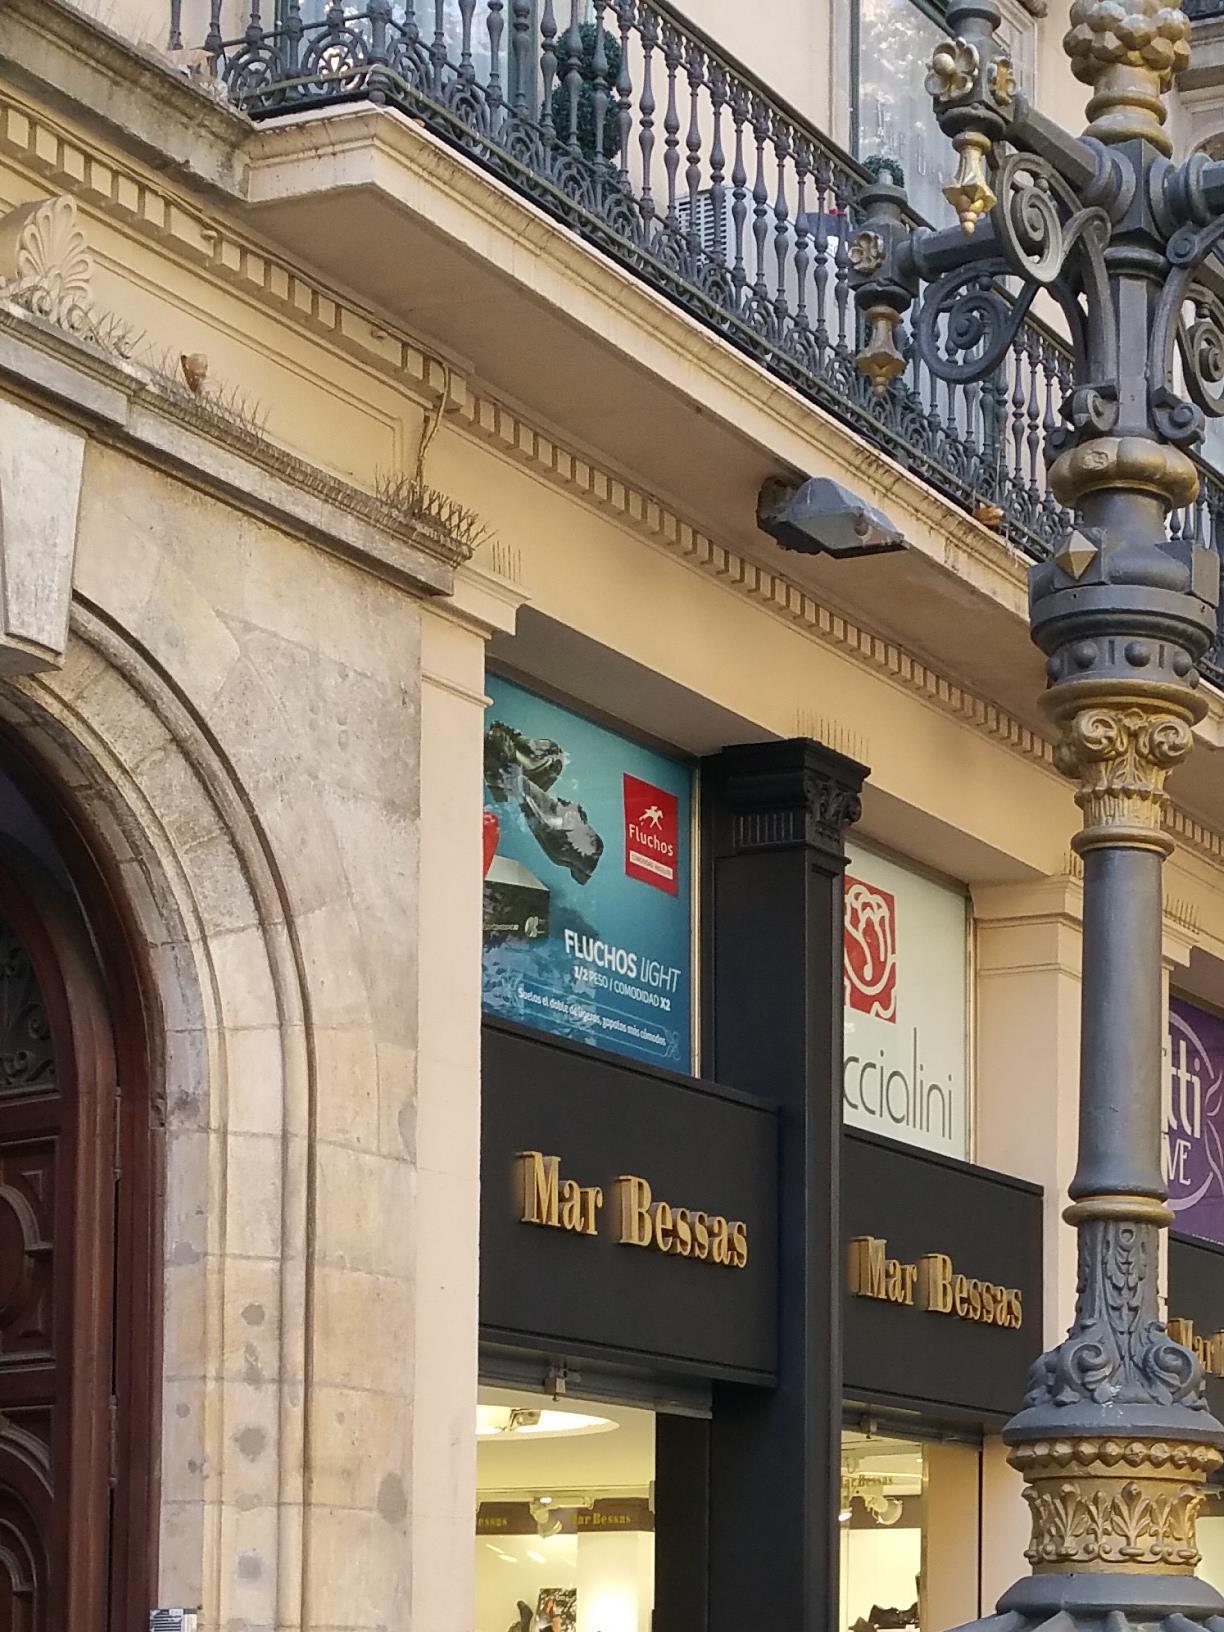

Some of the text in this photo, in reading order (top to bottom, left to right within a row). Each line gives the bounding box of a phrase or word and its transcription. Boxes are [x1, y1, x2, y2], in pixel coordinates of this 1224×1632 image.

[629, 823, 673, 857] Fluchos
[564, 929, 682, 993] FLUCHOS LIGHT
[588, 970, 609, 989] PESO
[613, 980, 660, 1007] COMODIDAD
[659, 996, 671, 1011] X2
[518, 1150, 748, 1269] Mar Bessas
[850, 1235, 1023, 1330] Mar Bessas
